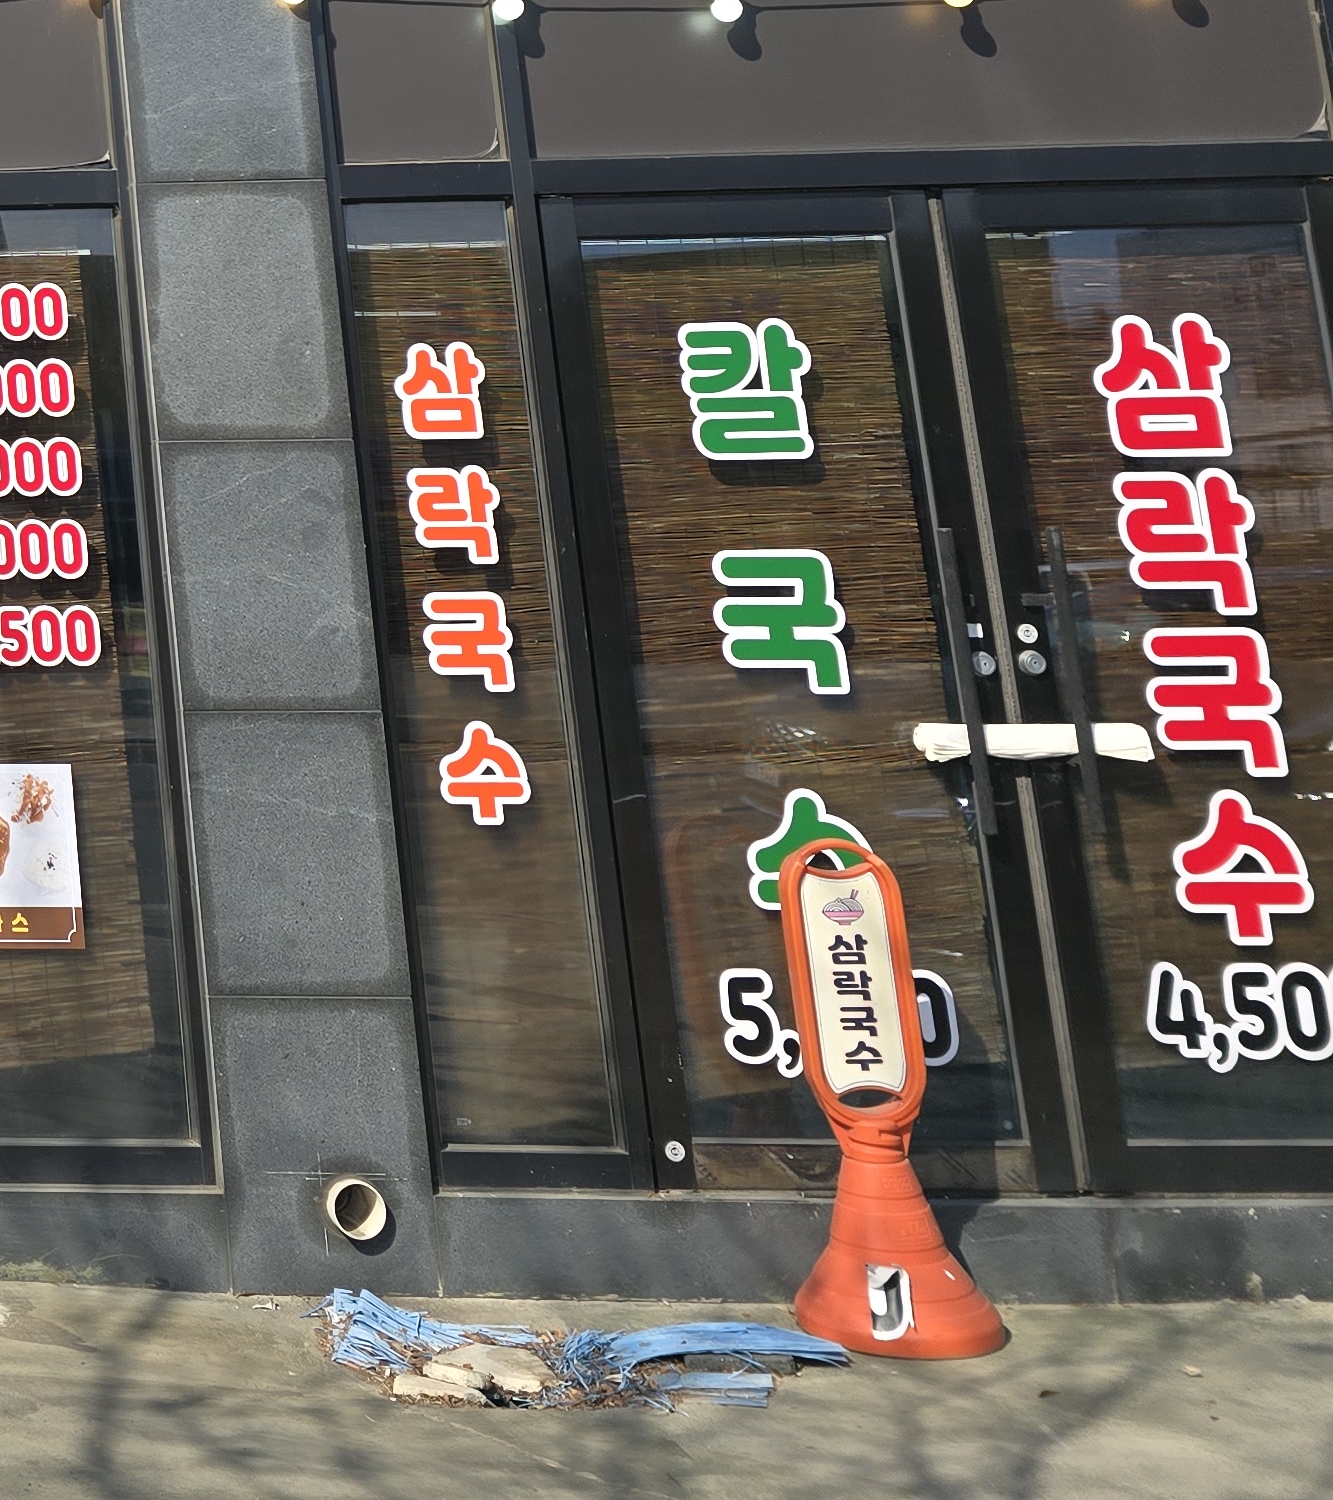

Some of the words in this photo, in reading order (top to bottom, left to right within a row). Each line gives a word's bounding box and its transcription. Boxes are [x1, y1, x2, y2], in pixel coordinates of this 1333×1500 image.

[394, 341, 531, 826] 삼락국수
[1093, 312, 1314, 947] 삼락국수
[719, 968, 960, 1079] 5,0
[826, 933, 884, 1073] 삼락국수
[1146, 960, 1333, 1073] 4,50
